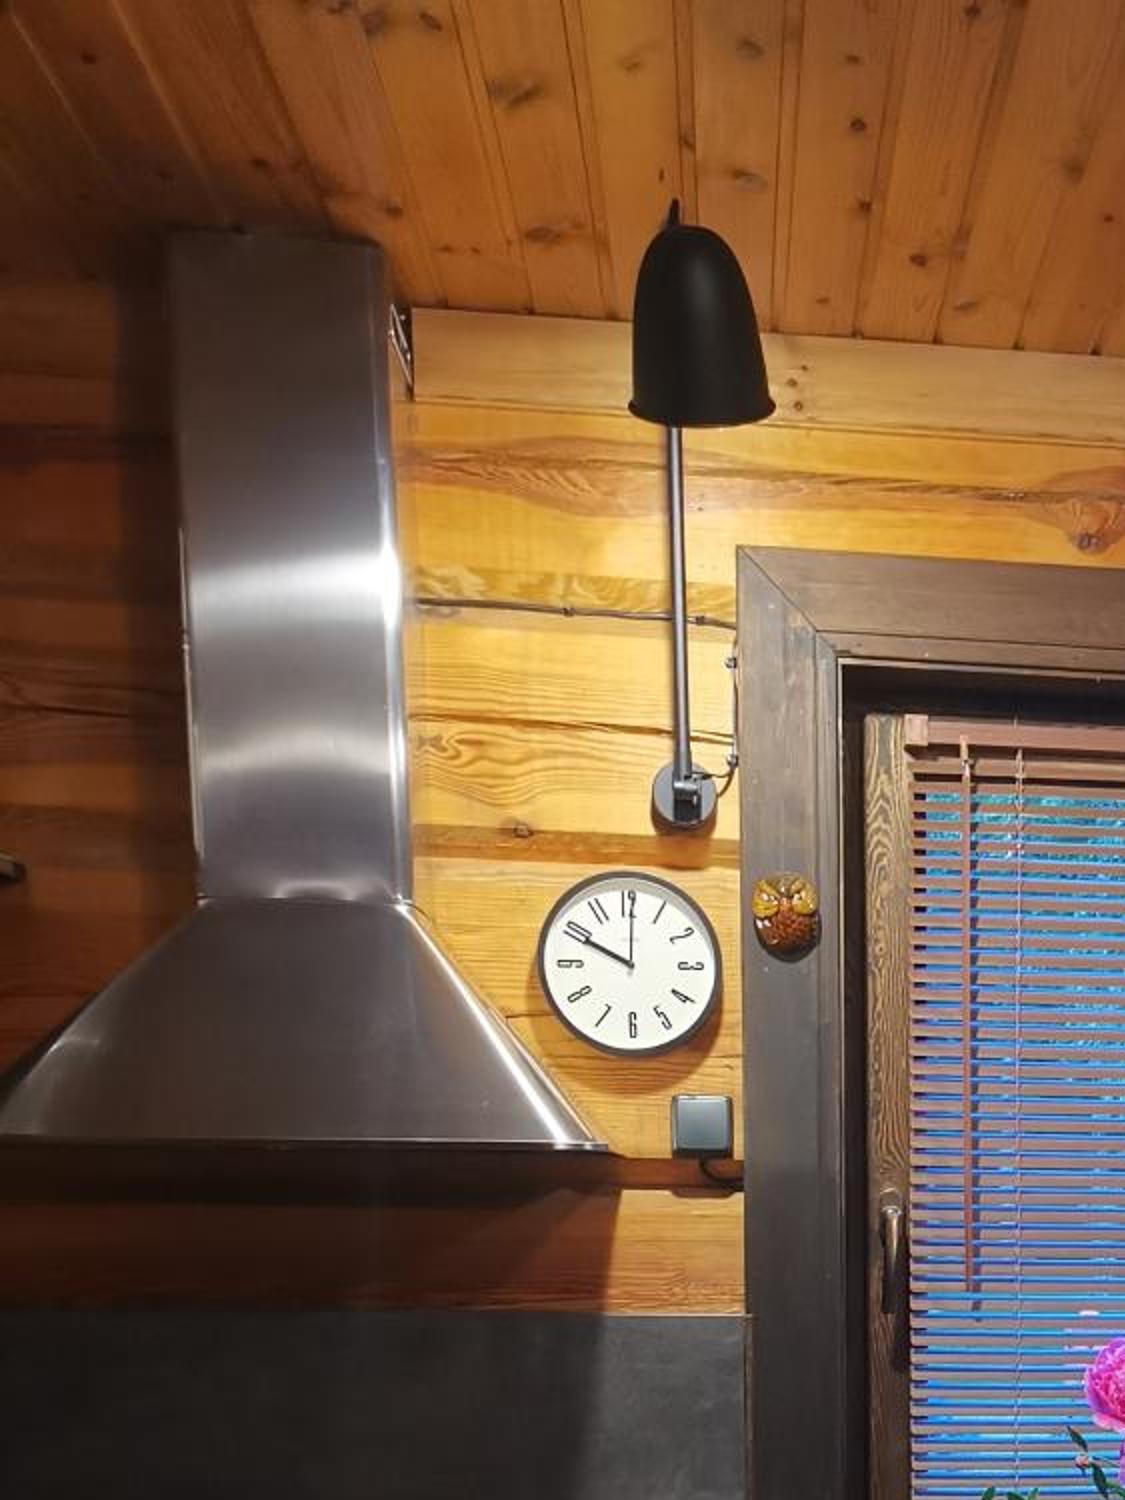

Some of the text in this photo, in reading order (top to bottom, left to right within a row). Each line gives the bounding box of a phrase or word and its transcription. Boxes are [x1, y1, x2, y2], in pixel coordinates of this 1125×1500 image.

[587, 897, 610, 925] 11
[621, 890, 637, 919] 12
[652, 900, 668, 925] 1
[563, 920, 593, 944] 10
[669, 926, 695, 945] 2
[556, 958, 585, 969] 9
[677, 961, 705, 971] 3
[567, 985, 593, 1003] 8
[670, 988, 696, 1004] 4
[594, 1003, 612, 1028] 7
[628, 1011, 638, 1039] 6
[653, 1005, 673, 1031] 5
